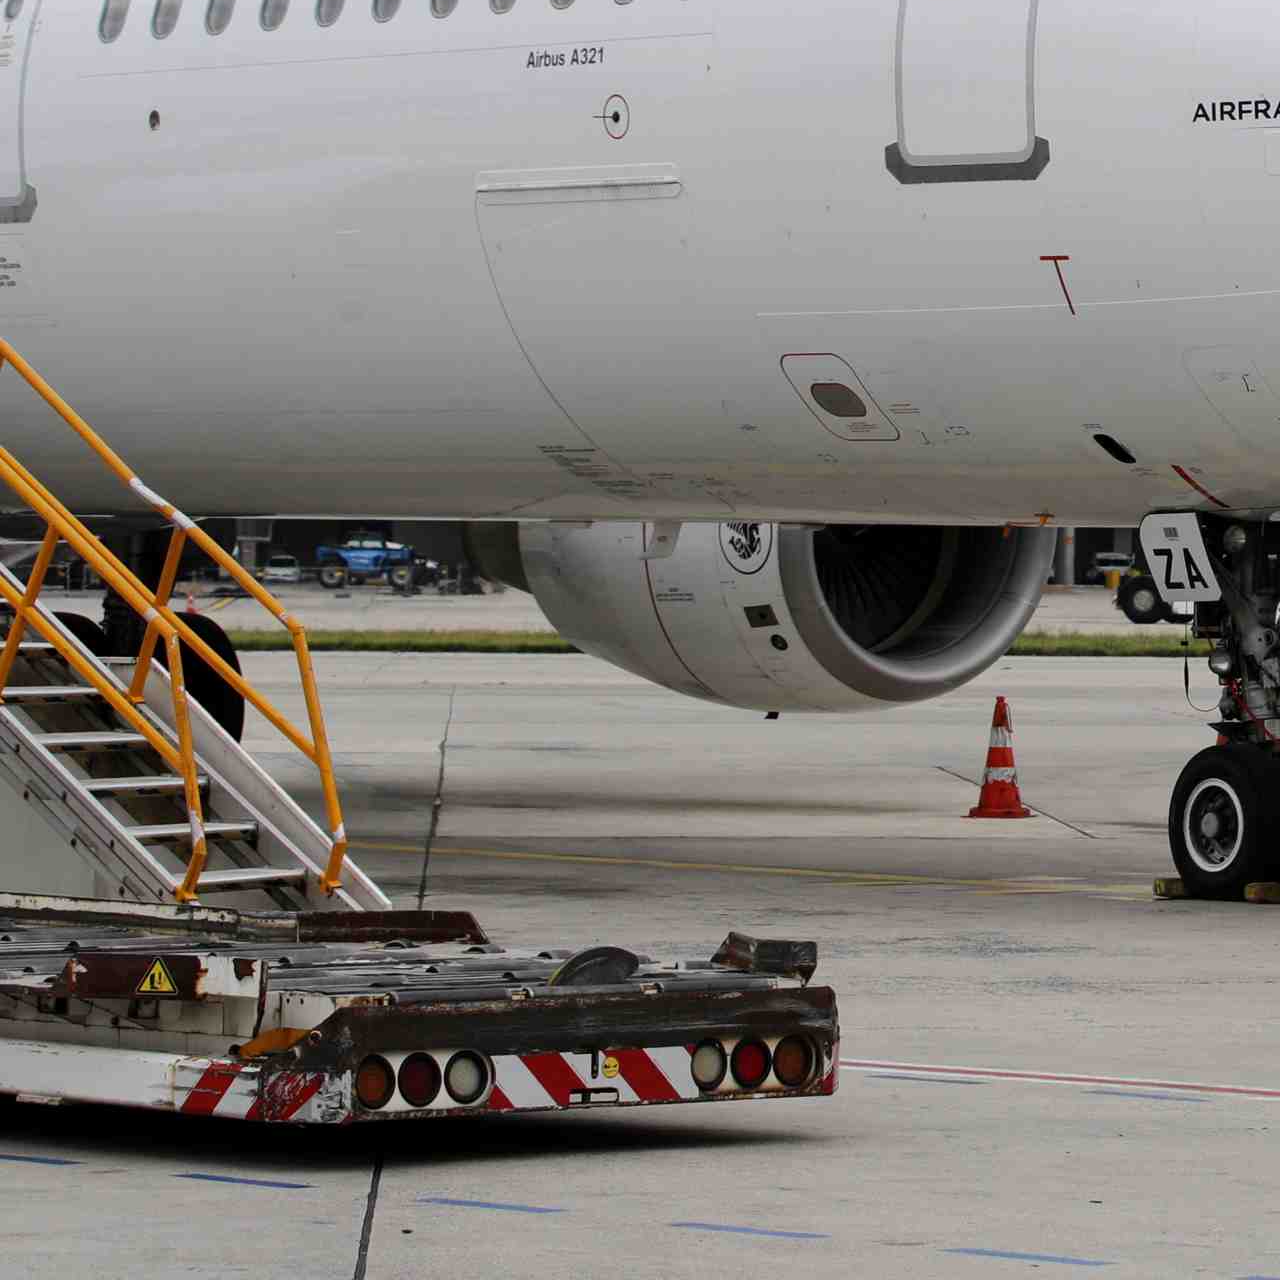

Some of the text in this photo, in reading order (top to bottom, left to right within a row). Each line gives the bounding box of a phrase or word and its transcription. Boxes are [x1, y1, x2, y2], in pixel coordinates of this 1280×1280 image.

[526, 46, 604, 68] Airbus A321
[1153, 548, 1209, 589] ZA
